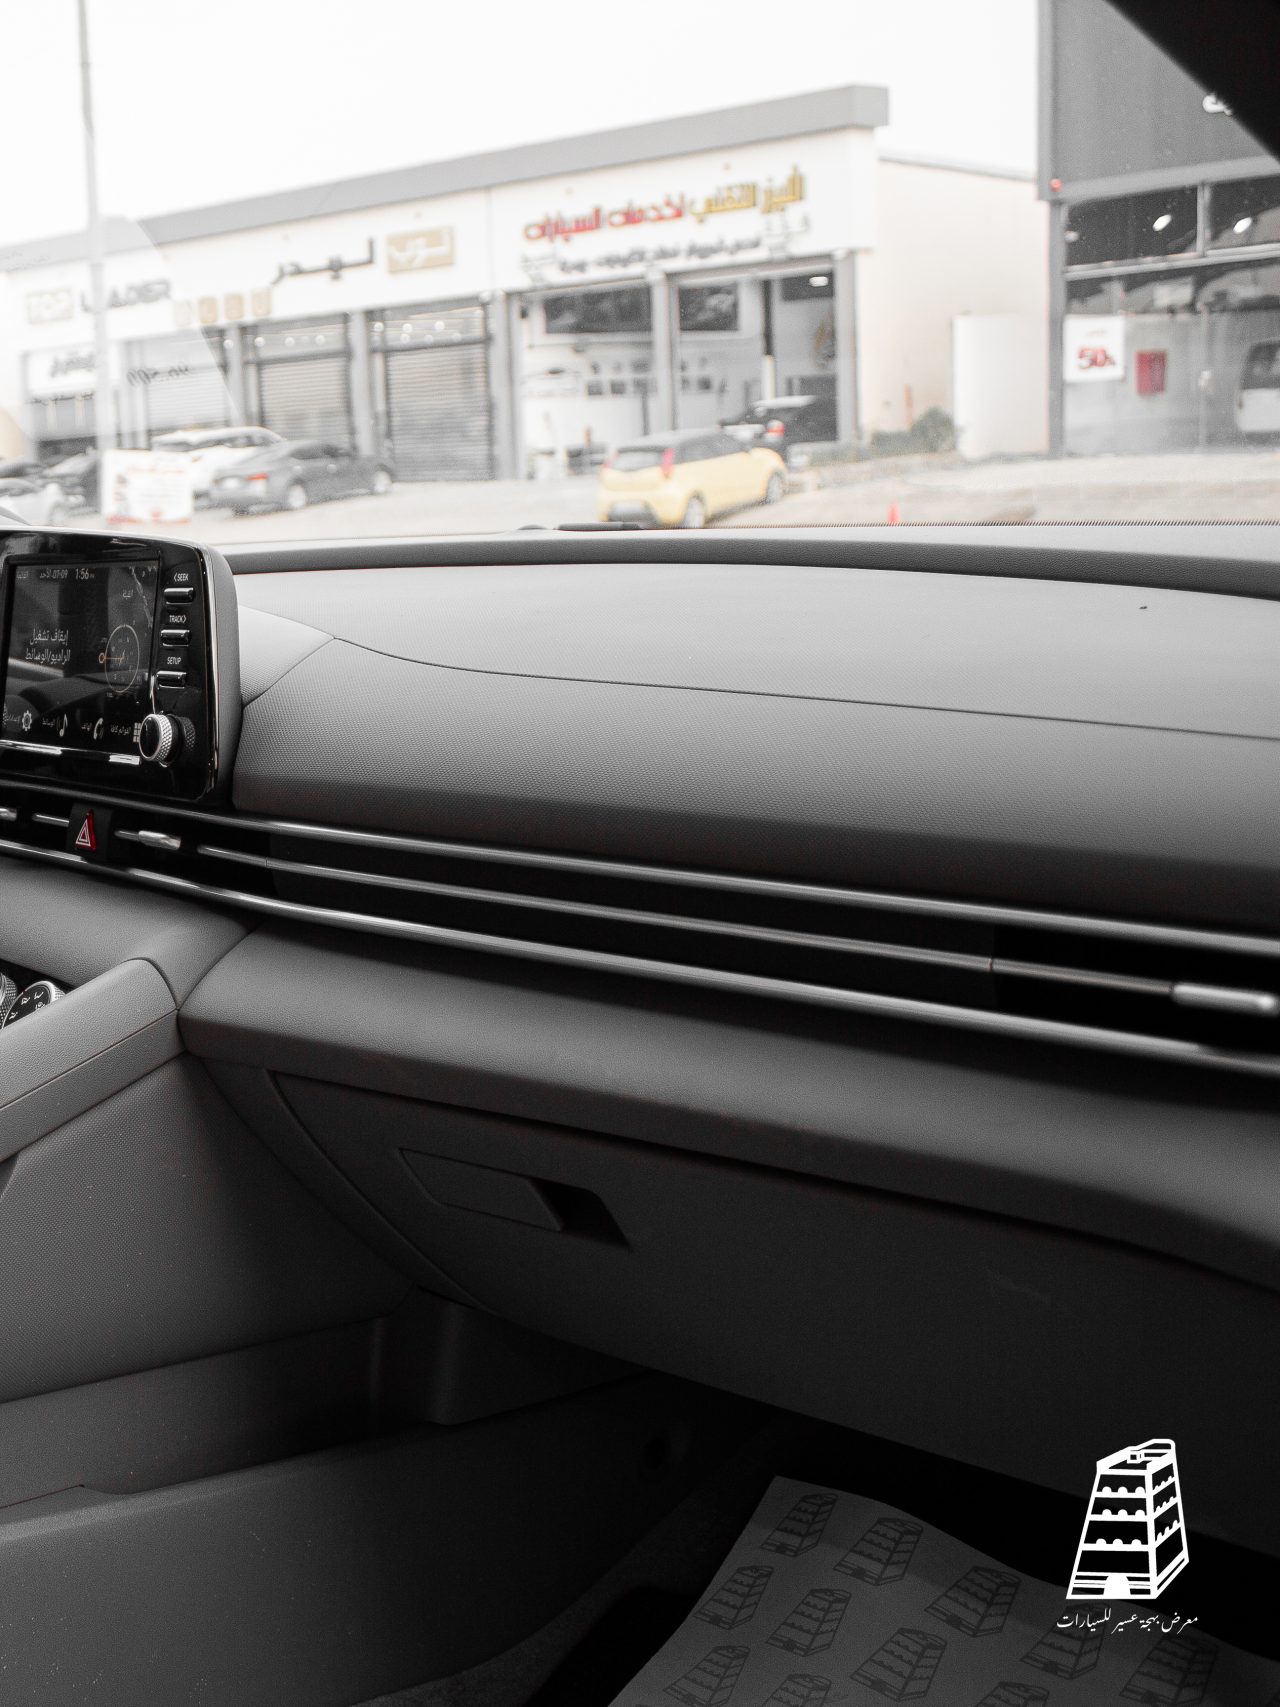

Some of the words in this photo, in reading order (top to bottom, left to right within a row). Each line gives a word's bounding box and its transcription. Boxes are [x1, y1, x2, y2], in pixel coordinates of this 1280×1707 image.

[522, 203, 602, 243] السيارات
[169, 614, 184, 624] TRACK
[29, 627, 50, 646] تشغيل
[50, 628, 69, 646] إيقاف
[25, 647, 71, 666] الراديو/الوسائط
[166, 656, 182, 666] SETUP
